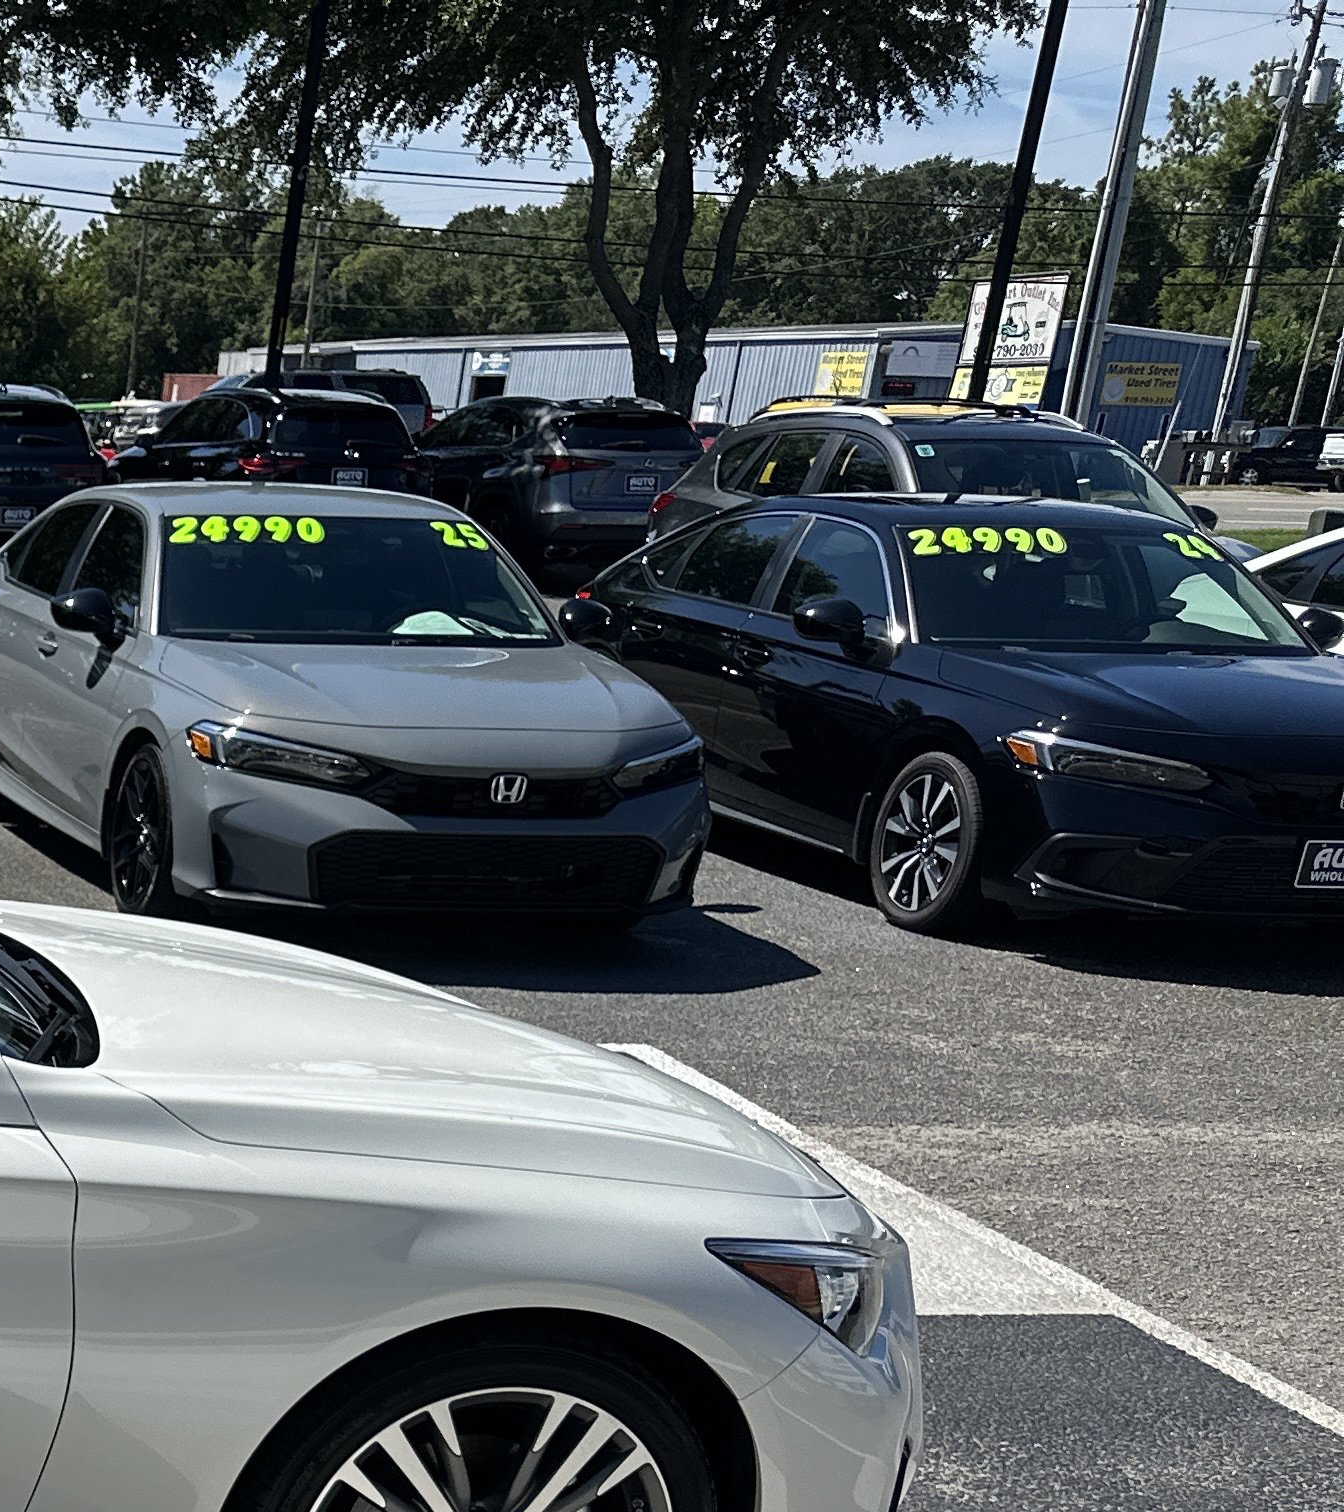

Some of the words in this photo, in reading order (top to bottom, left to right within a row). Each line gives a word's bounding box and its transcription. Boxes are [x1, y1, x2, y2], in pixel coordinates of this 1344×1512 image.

[1108, 363, 1145, 376] Market
[1147, 364, 1180, 377] Street
[1126, 378, 1152, 388] Used
[1153, 378, 1177, 389] Tires
[336, 471, 363, 480] AUTO
[169, 515, 326, 545] 24990
[430, 520, 490, 551] 25
[908, 527, 1067, 556] 24990
